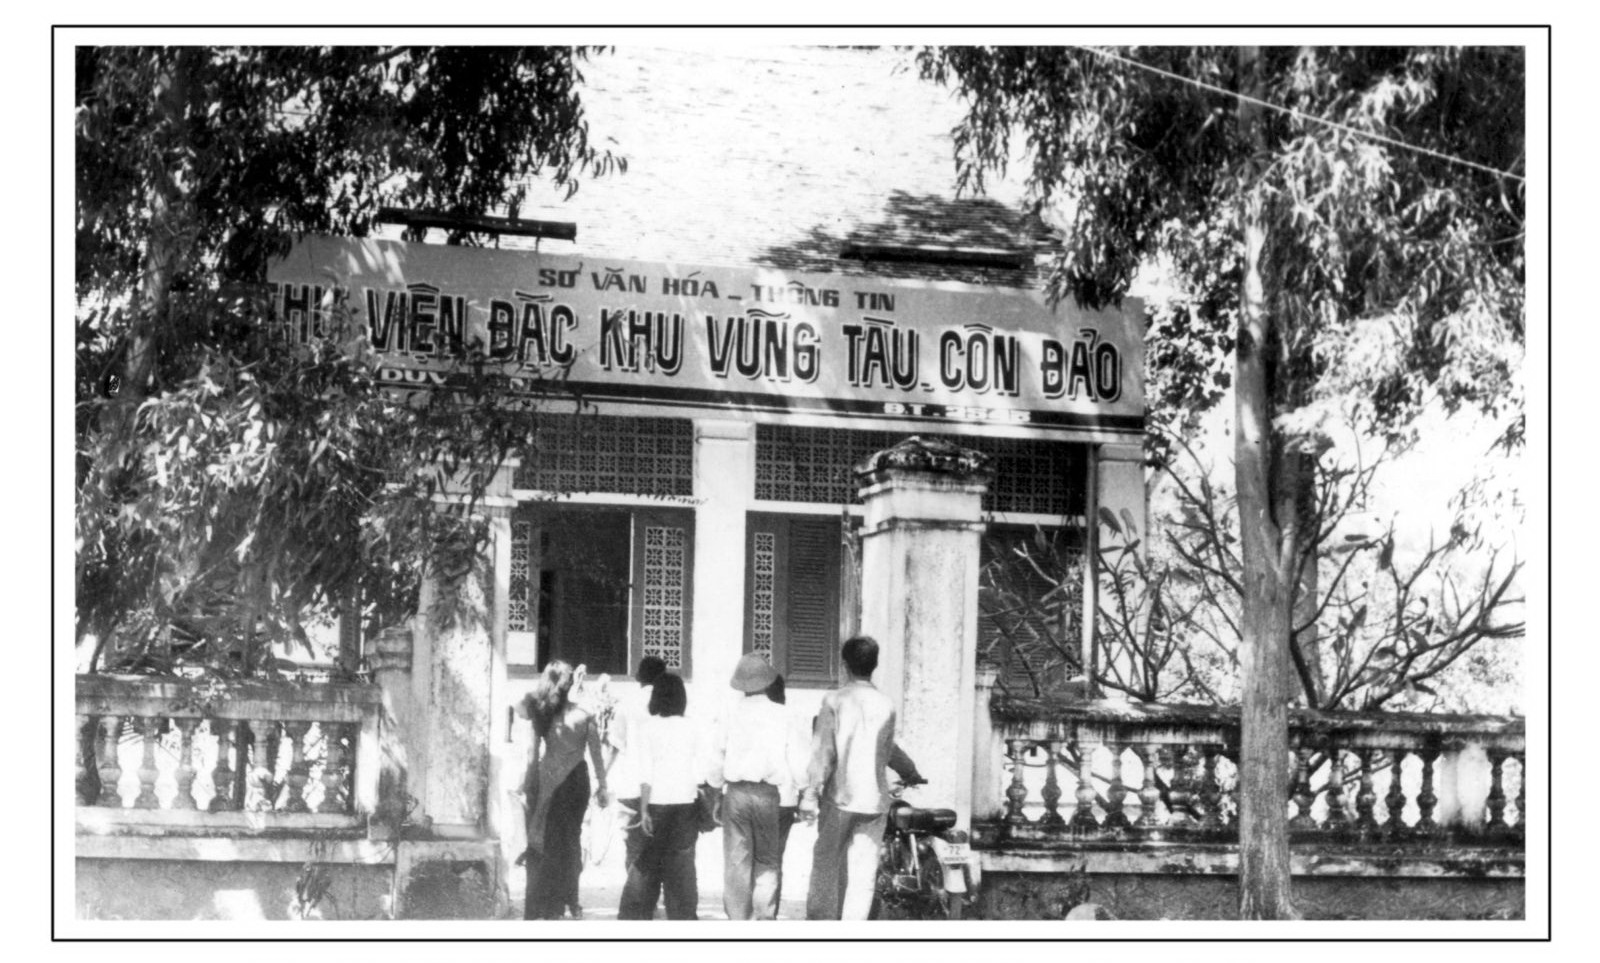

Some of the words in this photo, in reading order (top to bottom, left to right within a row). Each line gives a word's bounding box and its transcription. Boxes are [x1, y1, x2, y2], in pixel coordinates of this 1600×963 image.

[591, 267, 646, 294] VĂN
[662, 271, 719, 299] HÓA
[853, 290, 896, 312] TIN
[599, 307, 684, 377] KHU
[705, 307, 821, 384] VŨNG
[842, 316, 919, 392] TÀU
[939, 322, 1021, 397] CÔN
[1041, 328, 1123, 403] ĐẢO
